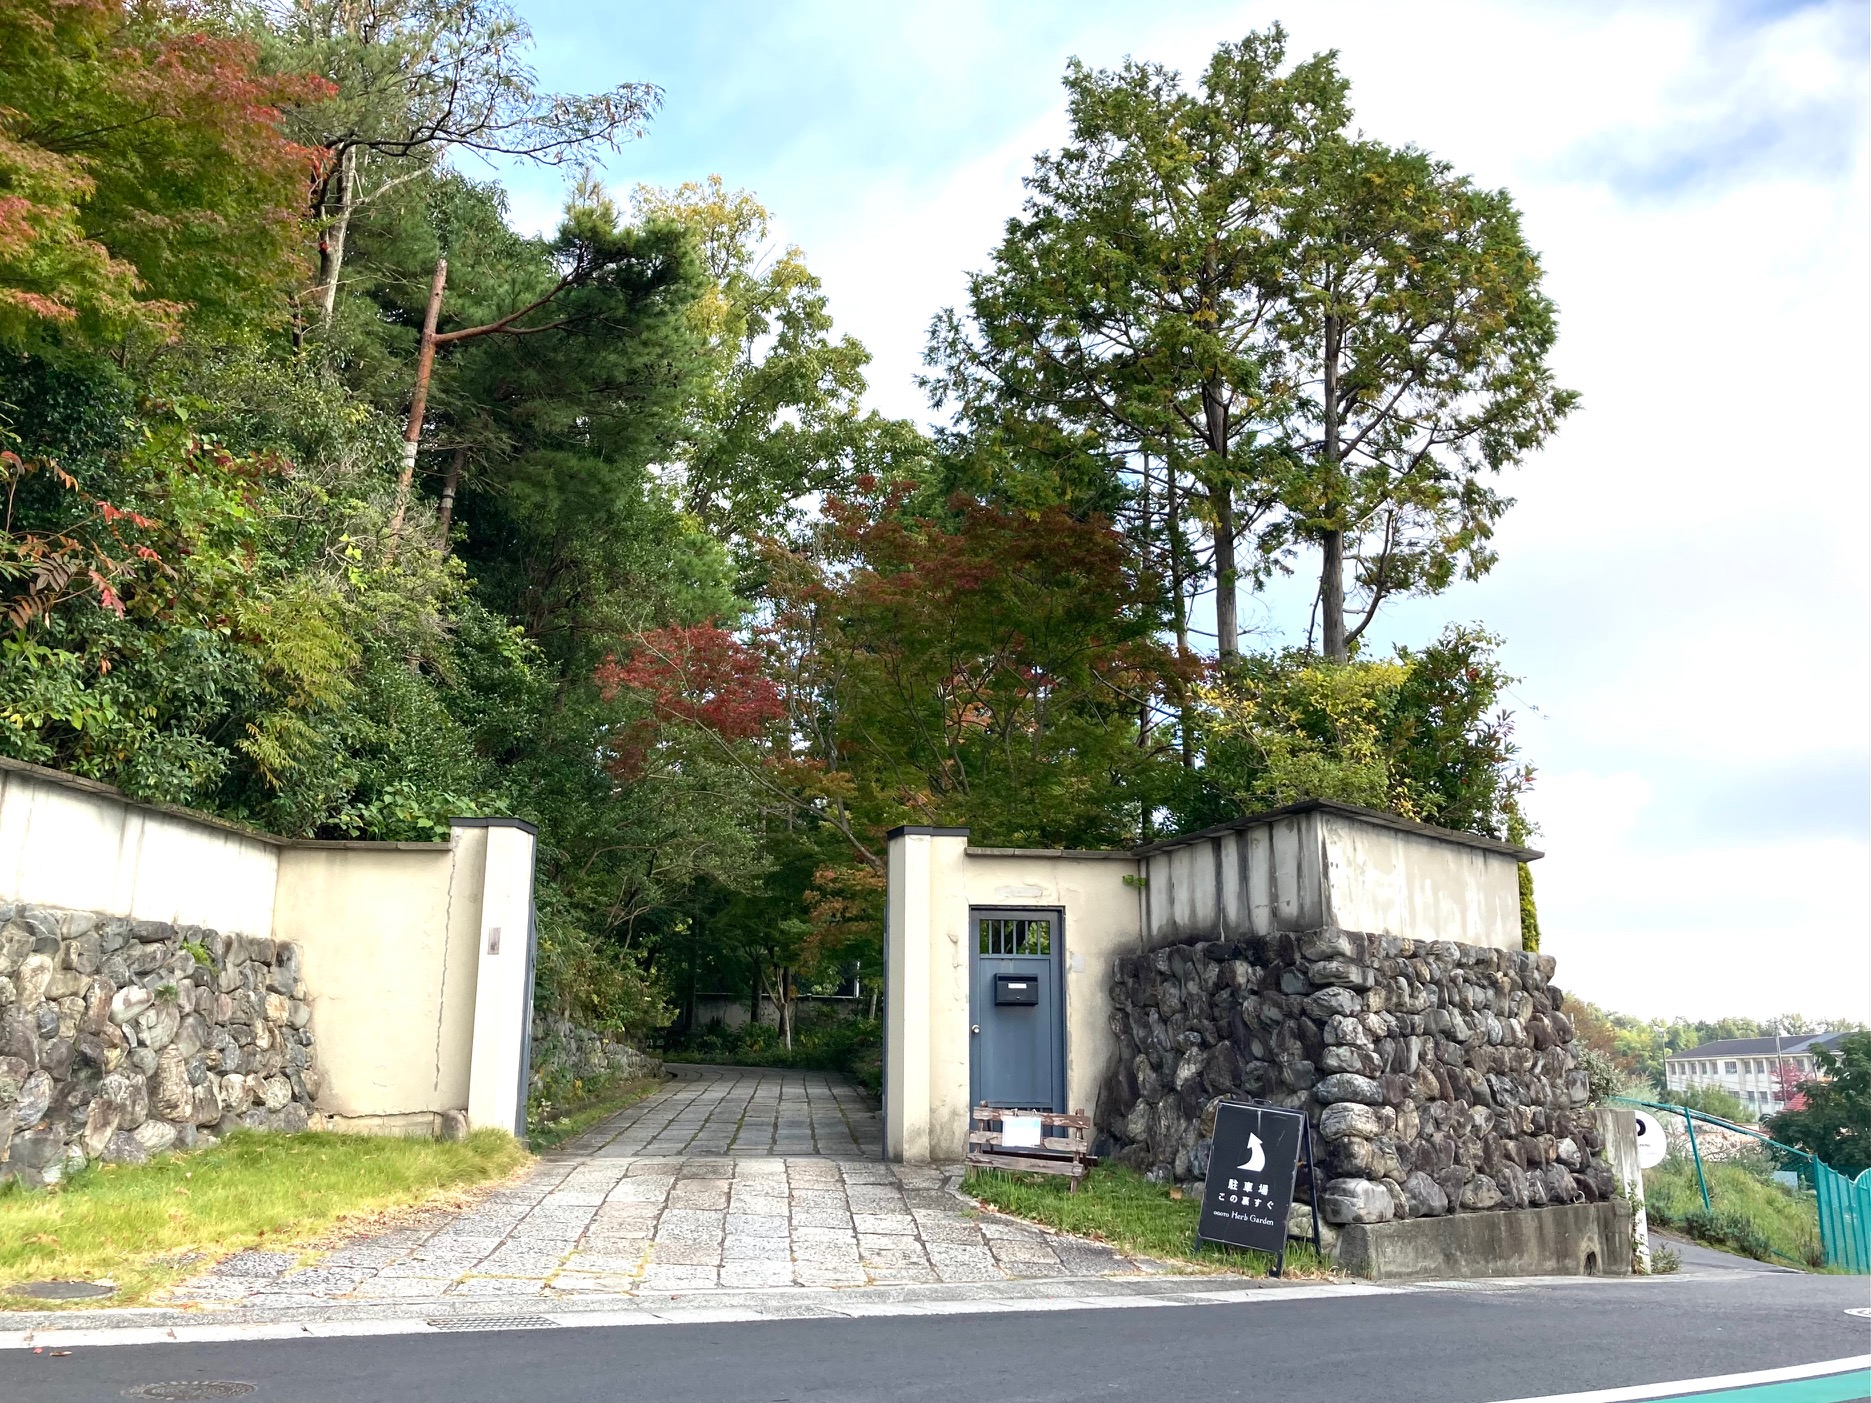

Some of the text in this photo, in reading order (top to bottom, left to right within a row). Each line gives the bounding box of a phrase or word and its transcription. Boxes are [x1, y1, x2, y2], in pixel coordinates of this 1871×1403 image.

[1228, 1179, 1269, 1196] 駐車場
[1231, 1211, 1248, 1221] Herb
[1249, 1214, 1274, 1226] Garden
